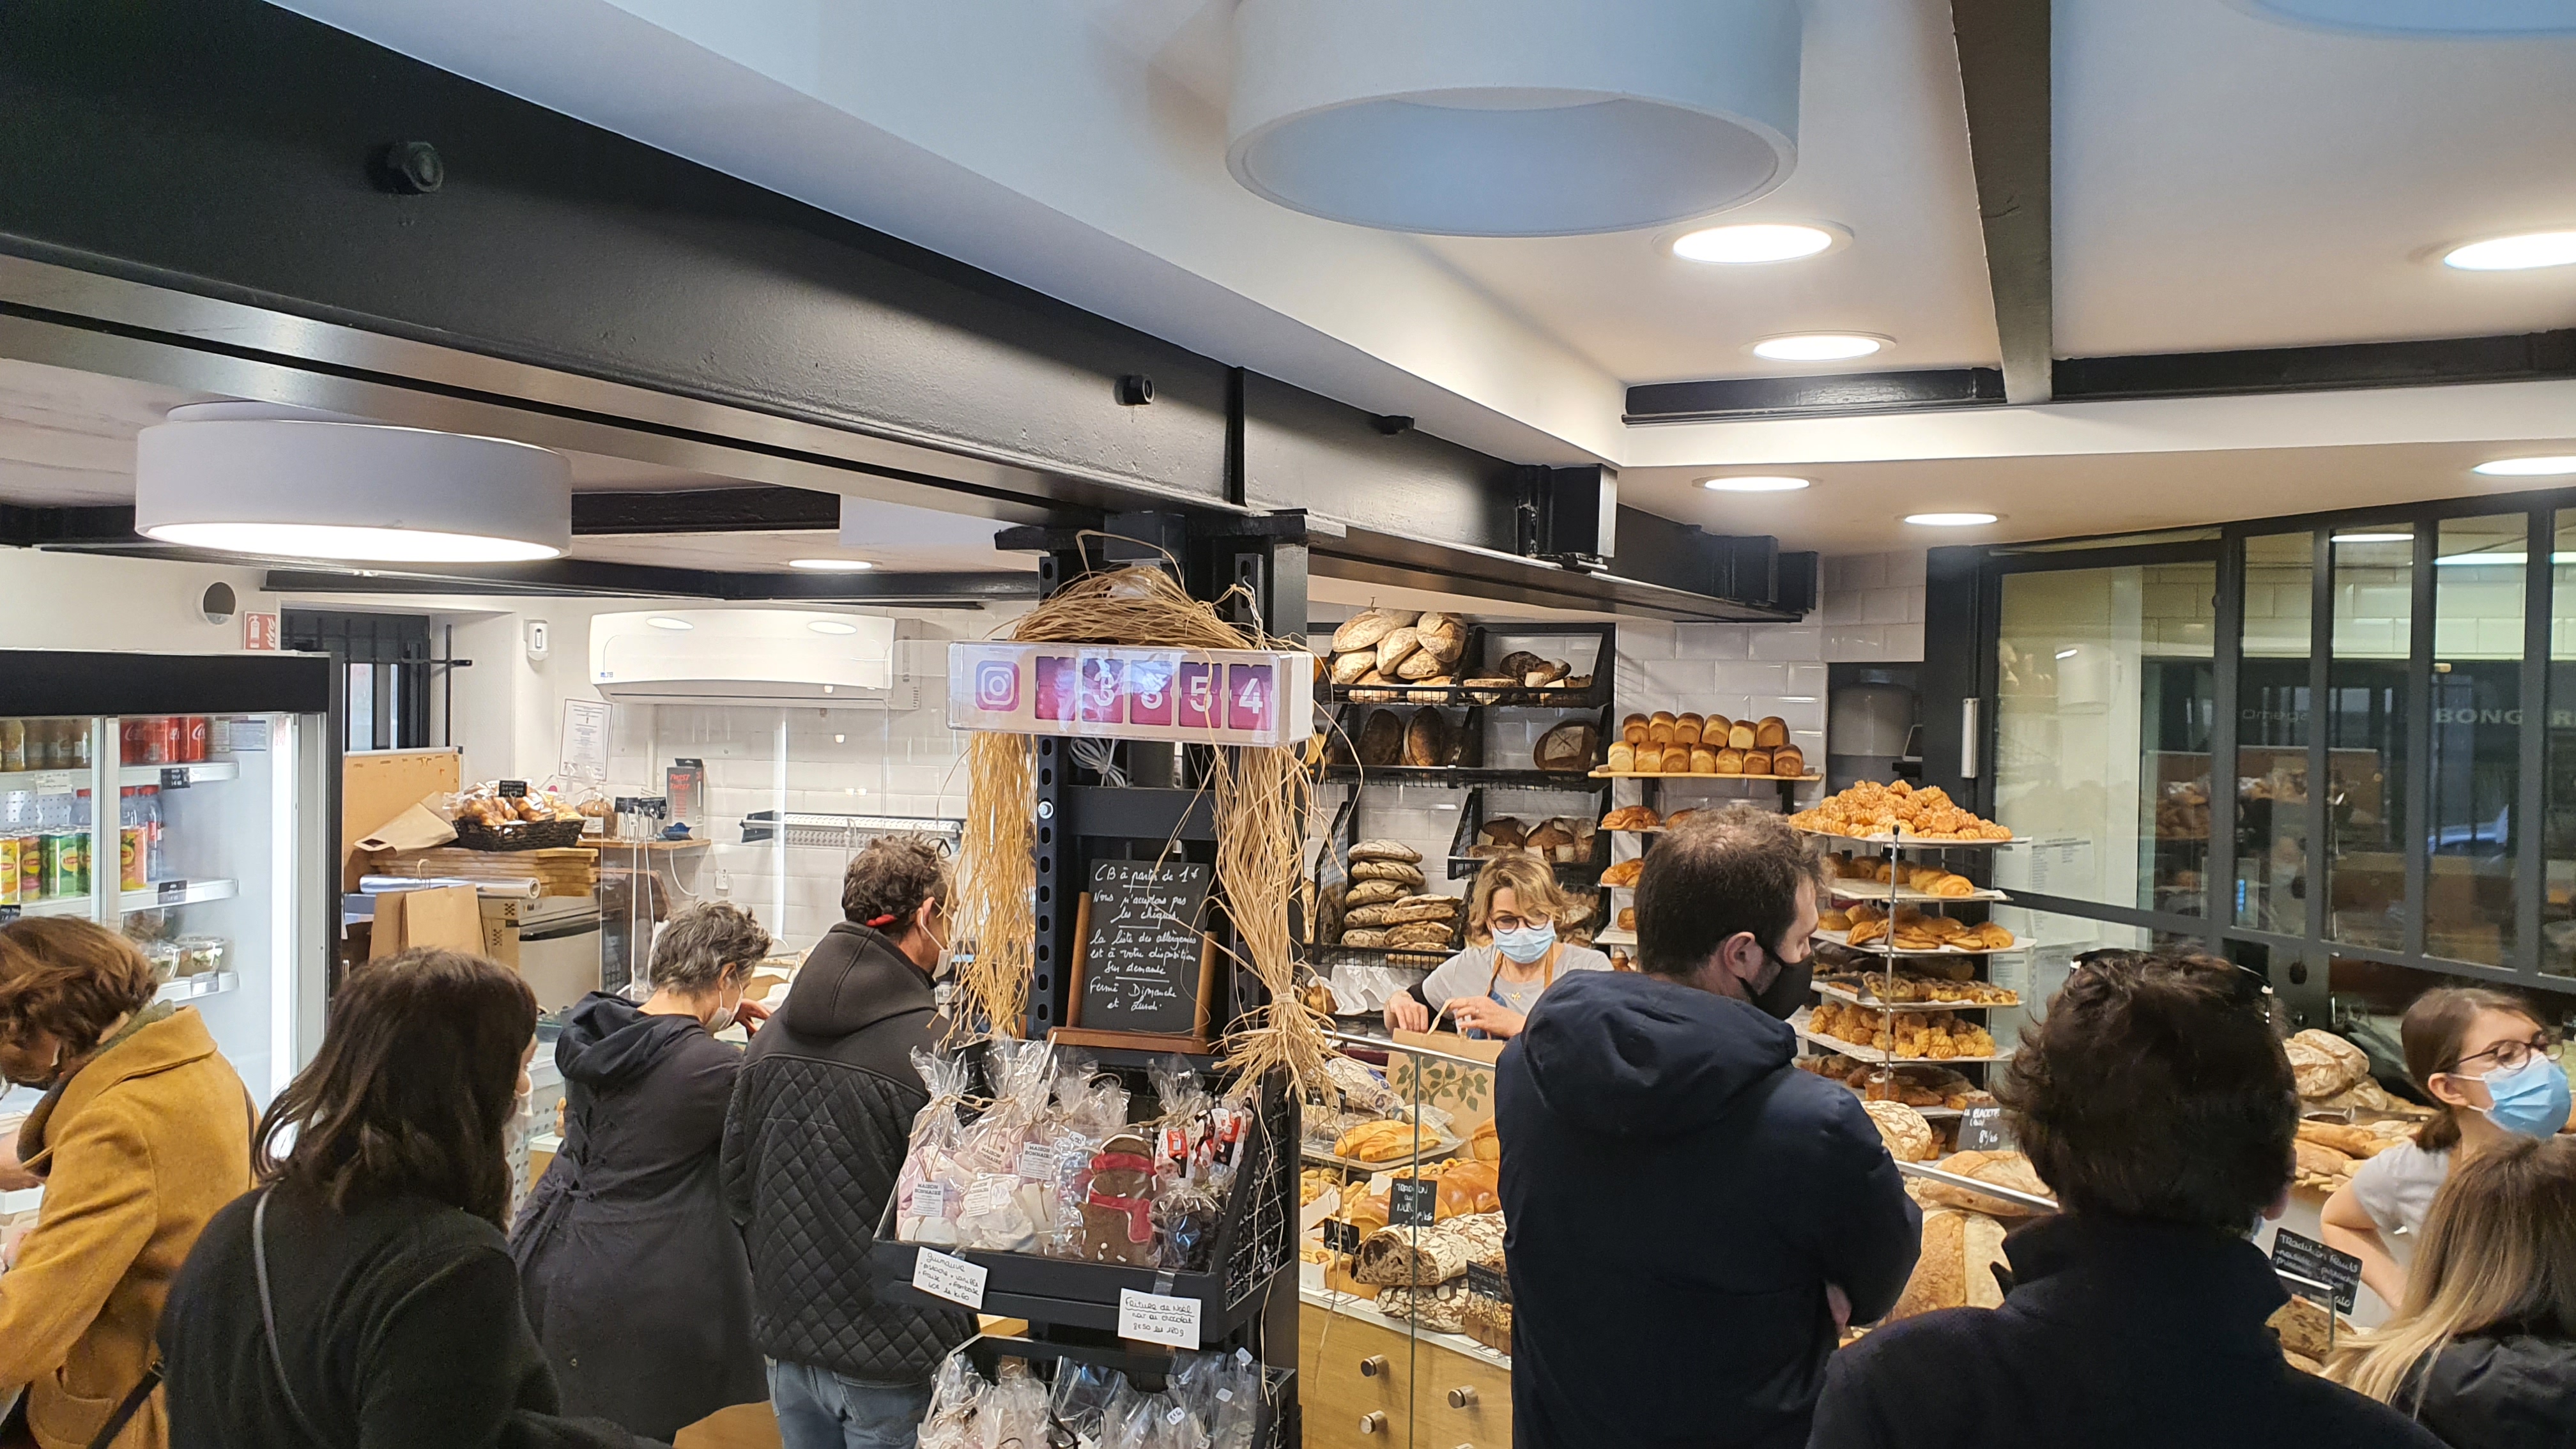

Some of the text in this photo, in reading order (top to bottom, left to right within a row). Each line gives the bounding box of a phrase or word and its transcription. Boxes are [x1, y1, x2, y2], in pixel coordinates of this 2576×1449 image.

[1095, 864, 1116, 881] CB
[1130, 868, 1158, 893] partr
[1162, 869, 1173, 882] de
[1093, 889, 1114, 903] Nous
[1169, 896, 1186, 913] pas
[1138, 931, 1152, 943] des
[1090, 947, 1104, 958] est
[1119, 947, 1144, 958] votre
[1126, 962, 1166, 974] demande
[1128, 983, 1177, 998] Dimanche
[1107, 997, 1119, 1009] et
